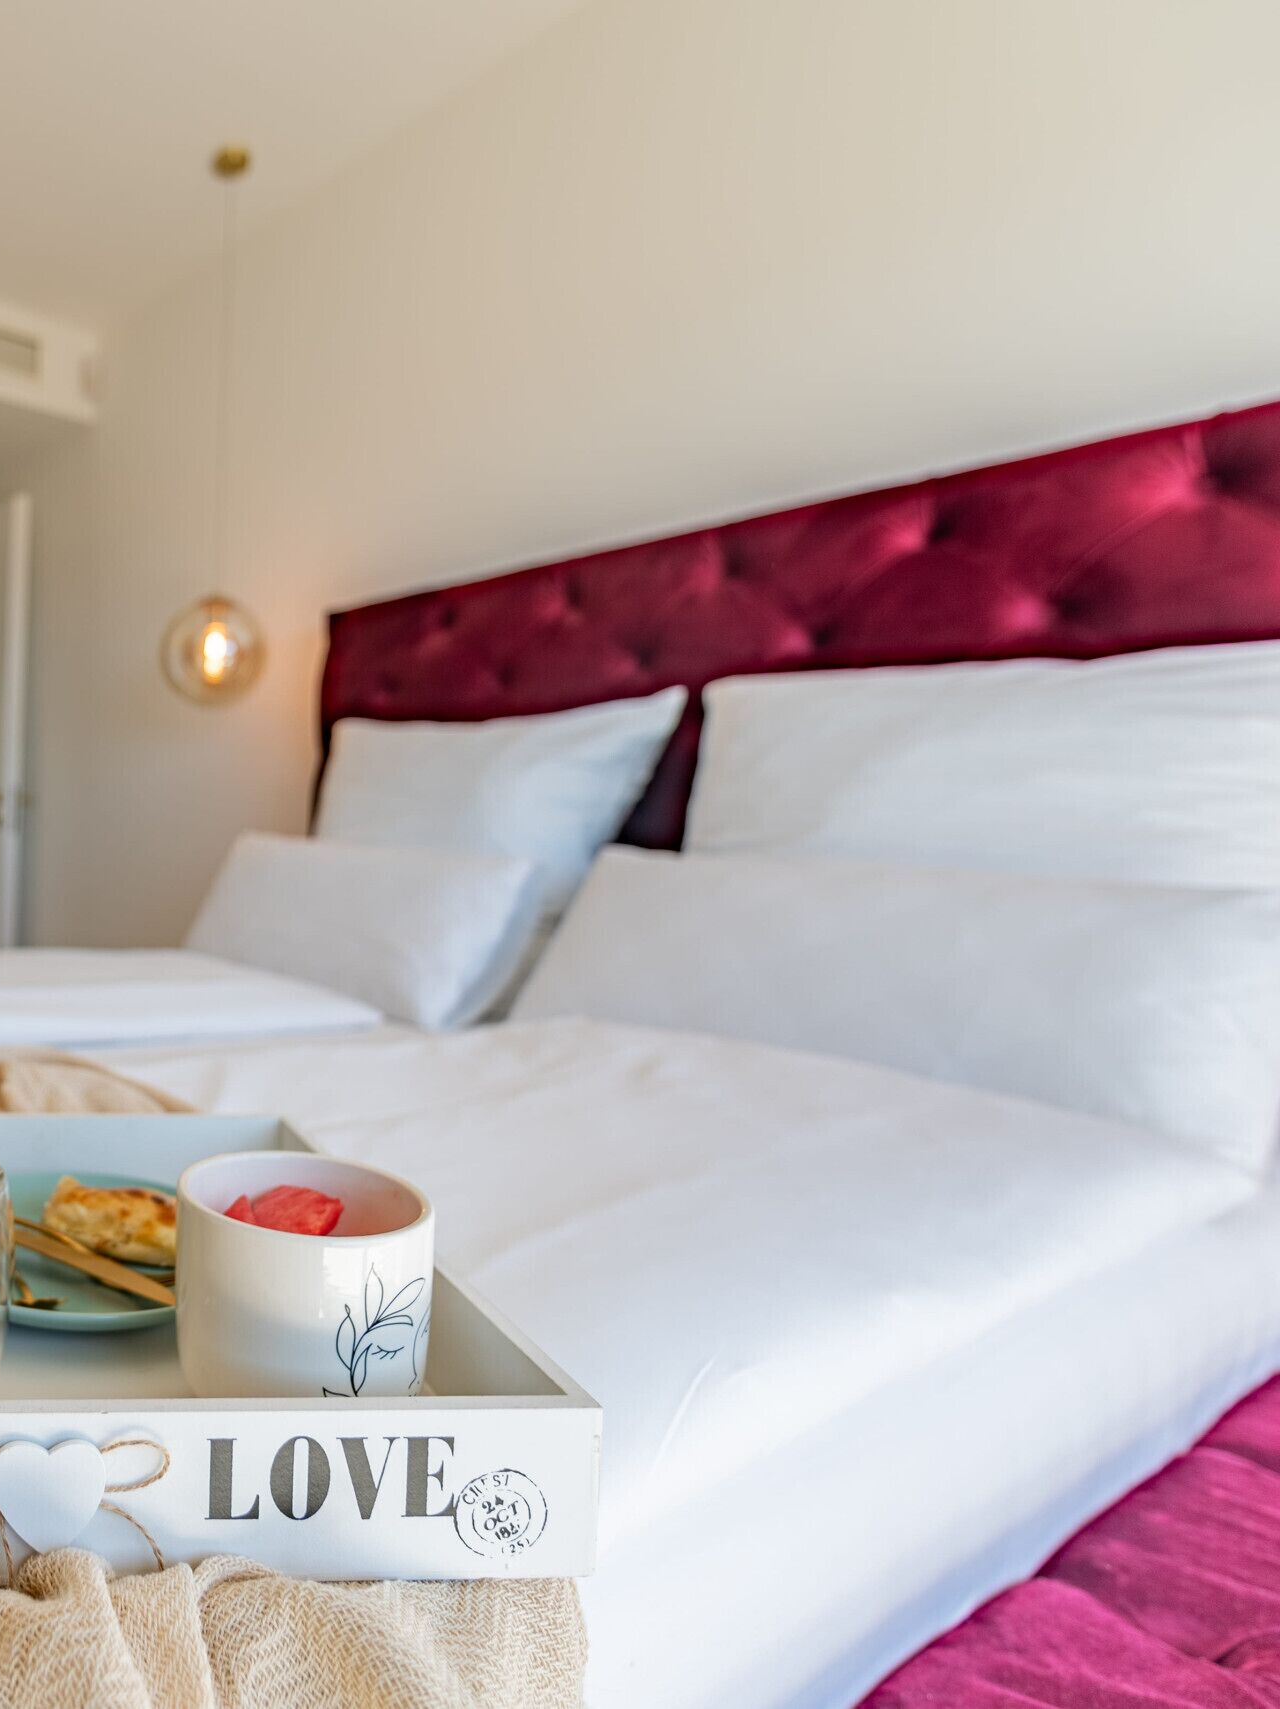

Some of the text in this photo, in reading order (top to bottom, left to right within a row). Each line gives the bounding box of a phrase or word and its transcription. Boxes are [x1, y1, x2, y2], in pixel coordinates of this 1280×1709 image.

[204, 1435, 455, 1521] LOVE
[481, 1495, 505, 1515] 24
[483, 1500, 519, 1531] OCT
